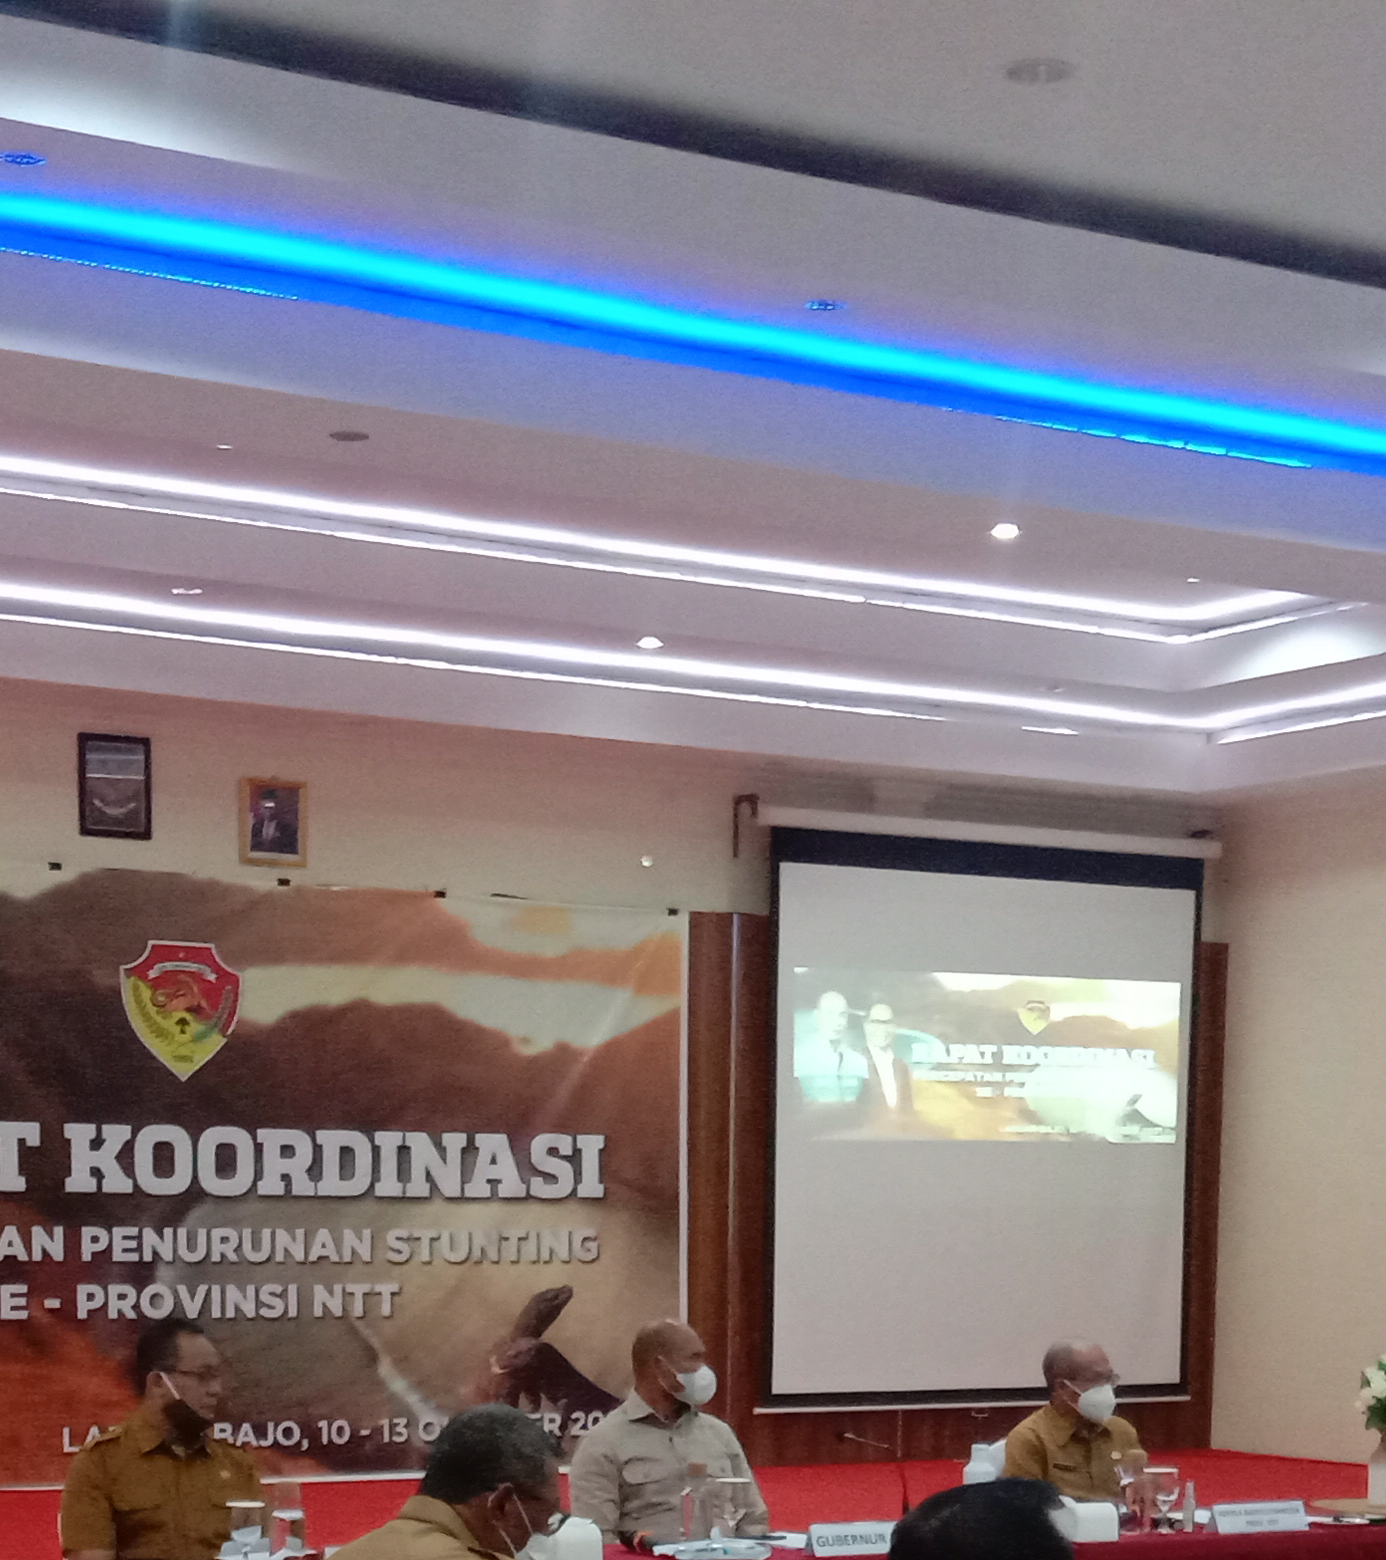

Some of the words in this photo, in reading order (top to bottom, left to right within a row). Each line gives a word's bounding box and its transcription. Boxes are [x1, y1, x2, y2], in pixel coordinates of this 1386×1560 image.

[63, 1122, 606, 1200] KOORDINASI
[81, 1225, 372, 1264] PENURUNAN
[385, 1227, 600, 1265] STUNTING
[76, 1282, 299, 1320] PROVINSI
[313, 1282, 401, 1319] NTT
[317, 1418, 352, 1446] 10
[379, 1416, 410, 1444] 13
[816, 1533, 888, 1547] GUBERNUR
